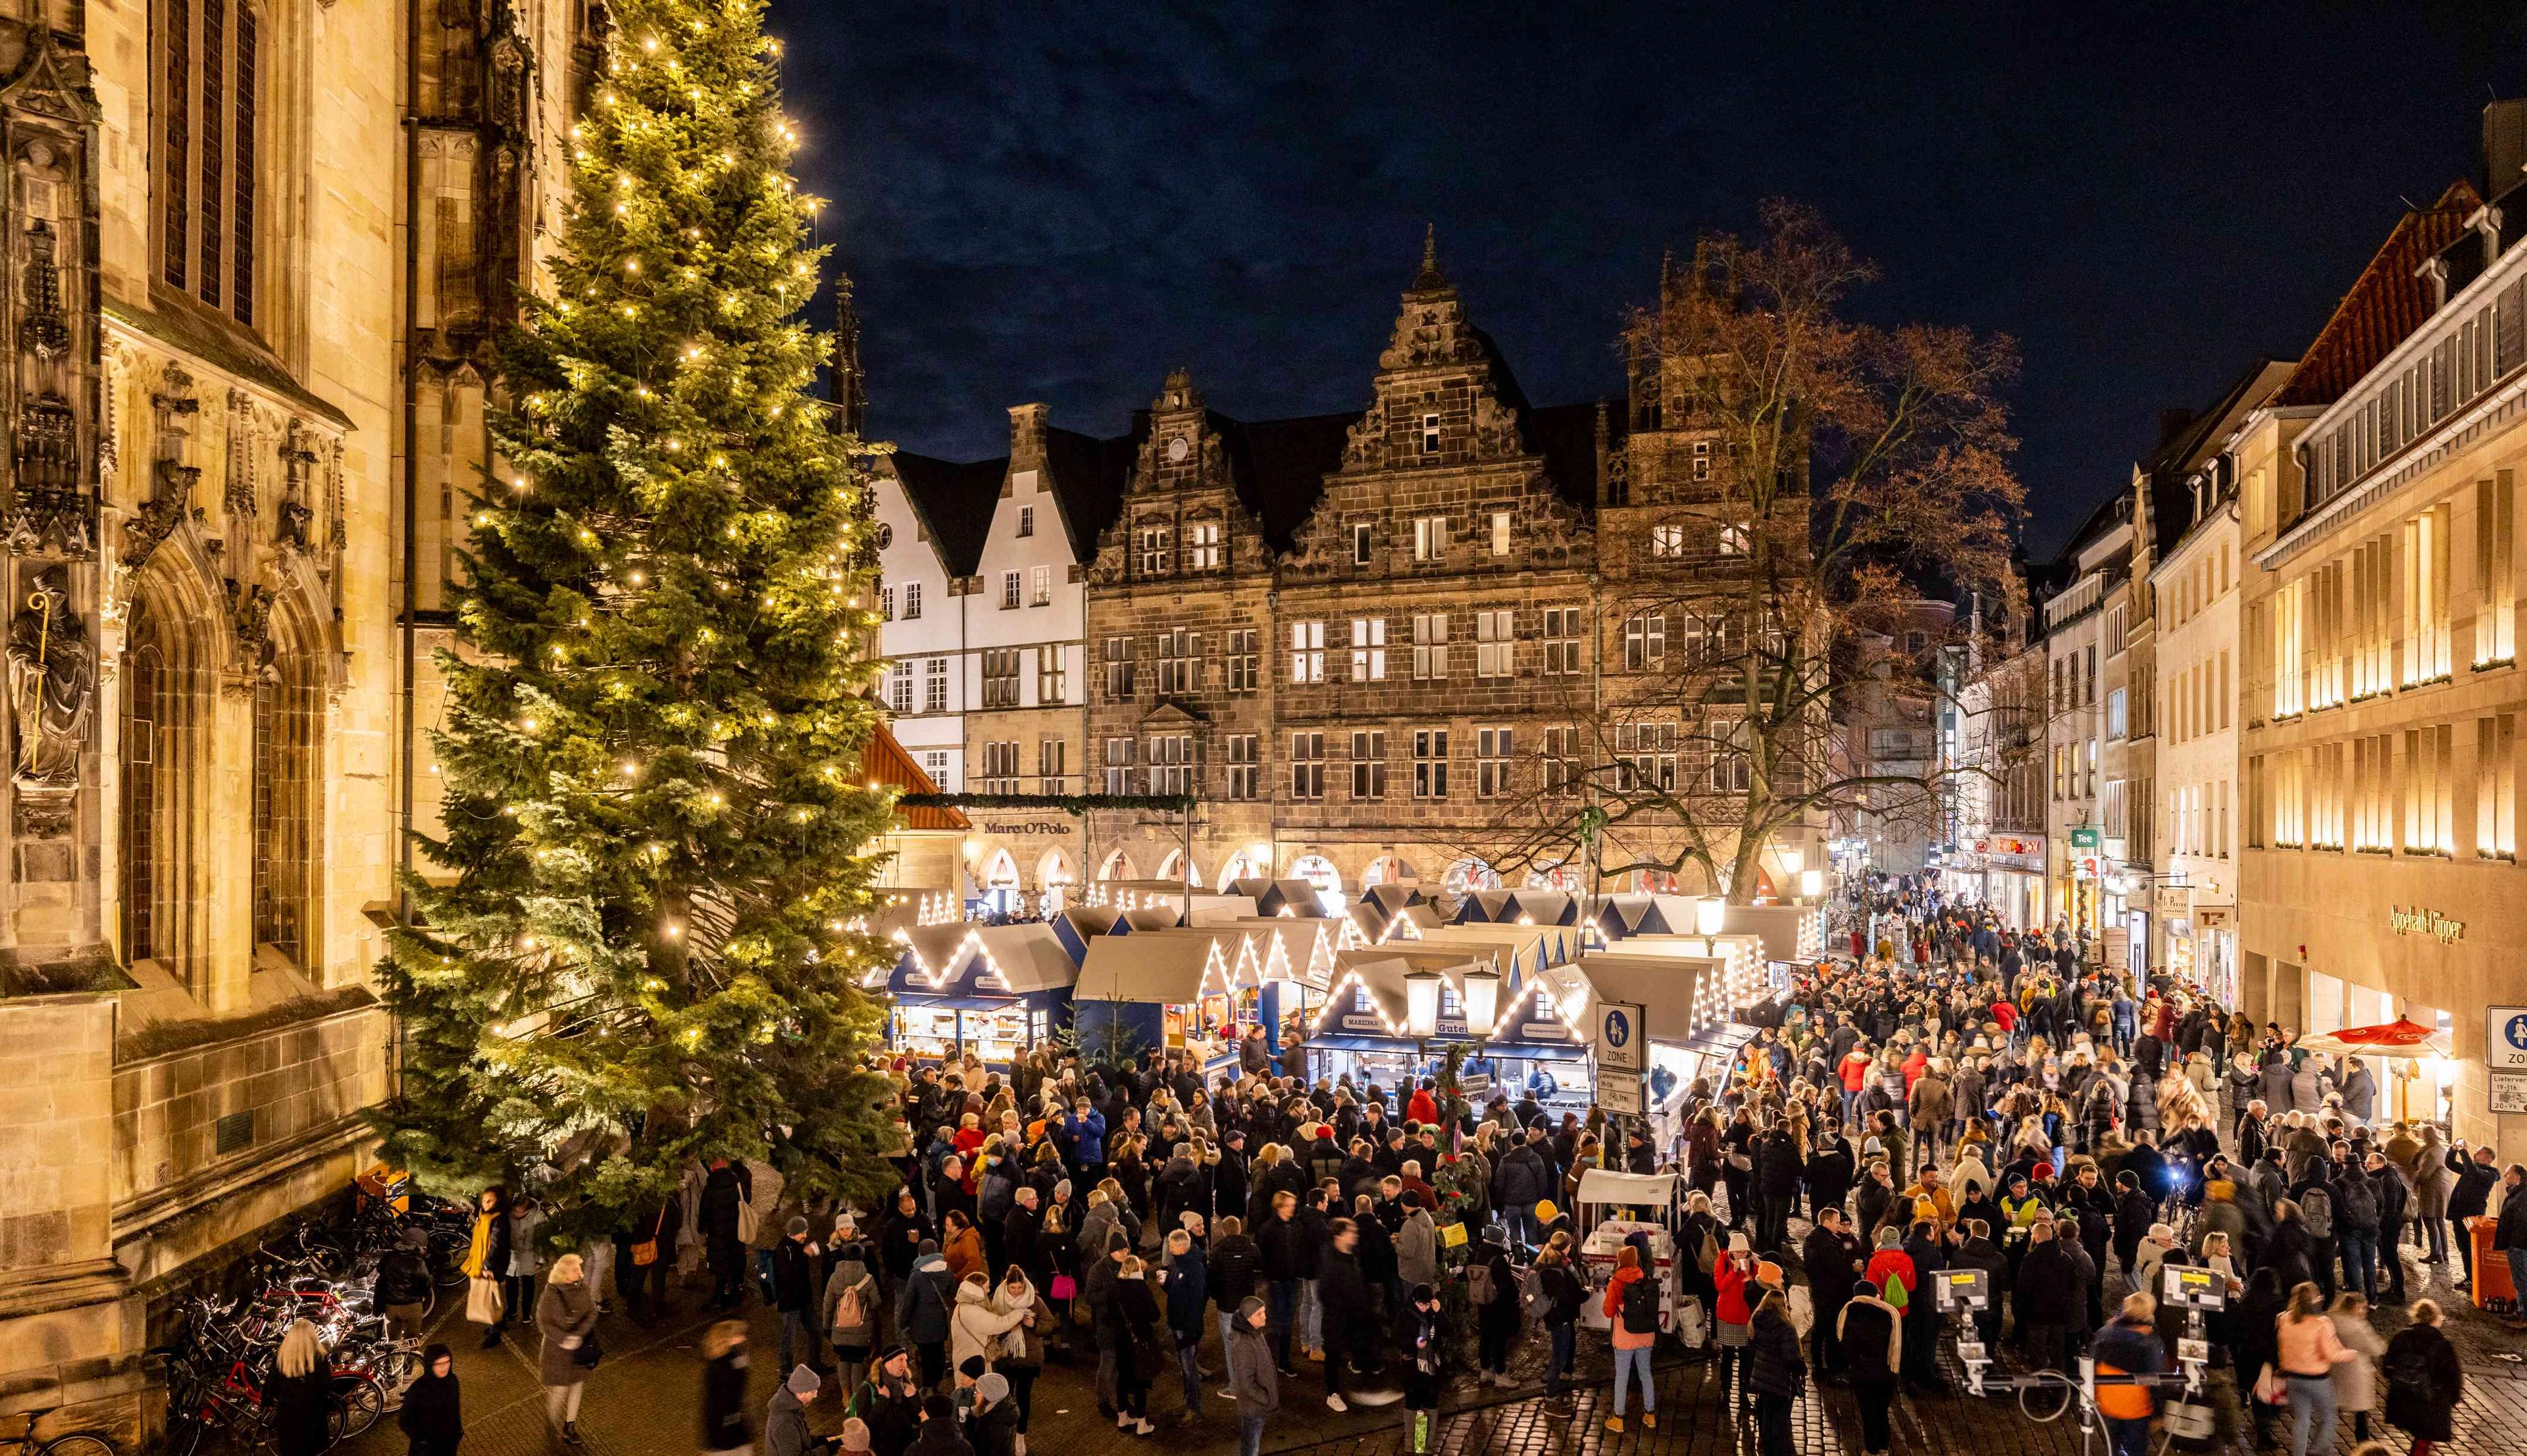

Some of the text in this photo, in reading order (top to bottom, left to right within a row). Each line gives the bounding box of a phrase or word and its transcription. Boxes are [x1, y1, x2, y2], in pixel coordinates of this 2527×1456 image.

[984, 822, 1070, 834] Marc O'Polo
[2076, 834, 2093, 843] Tee
[1607, 1051, 1627, 1063] ZONE
[2509, 1053, 2527, 1063] ZO
